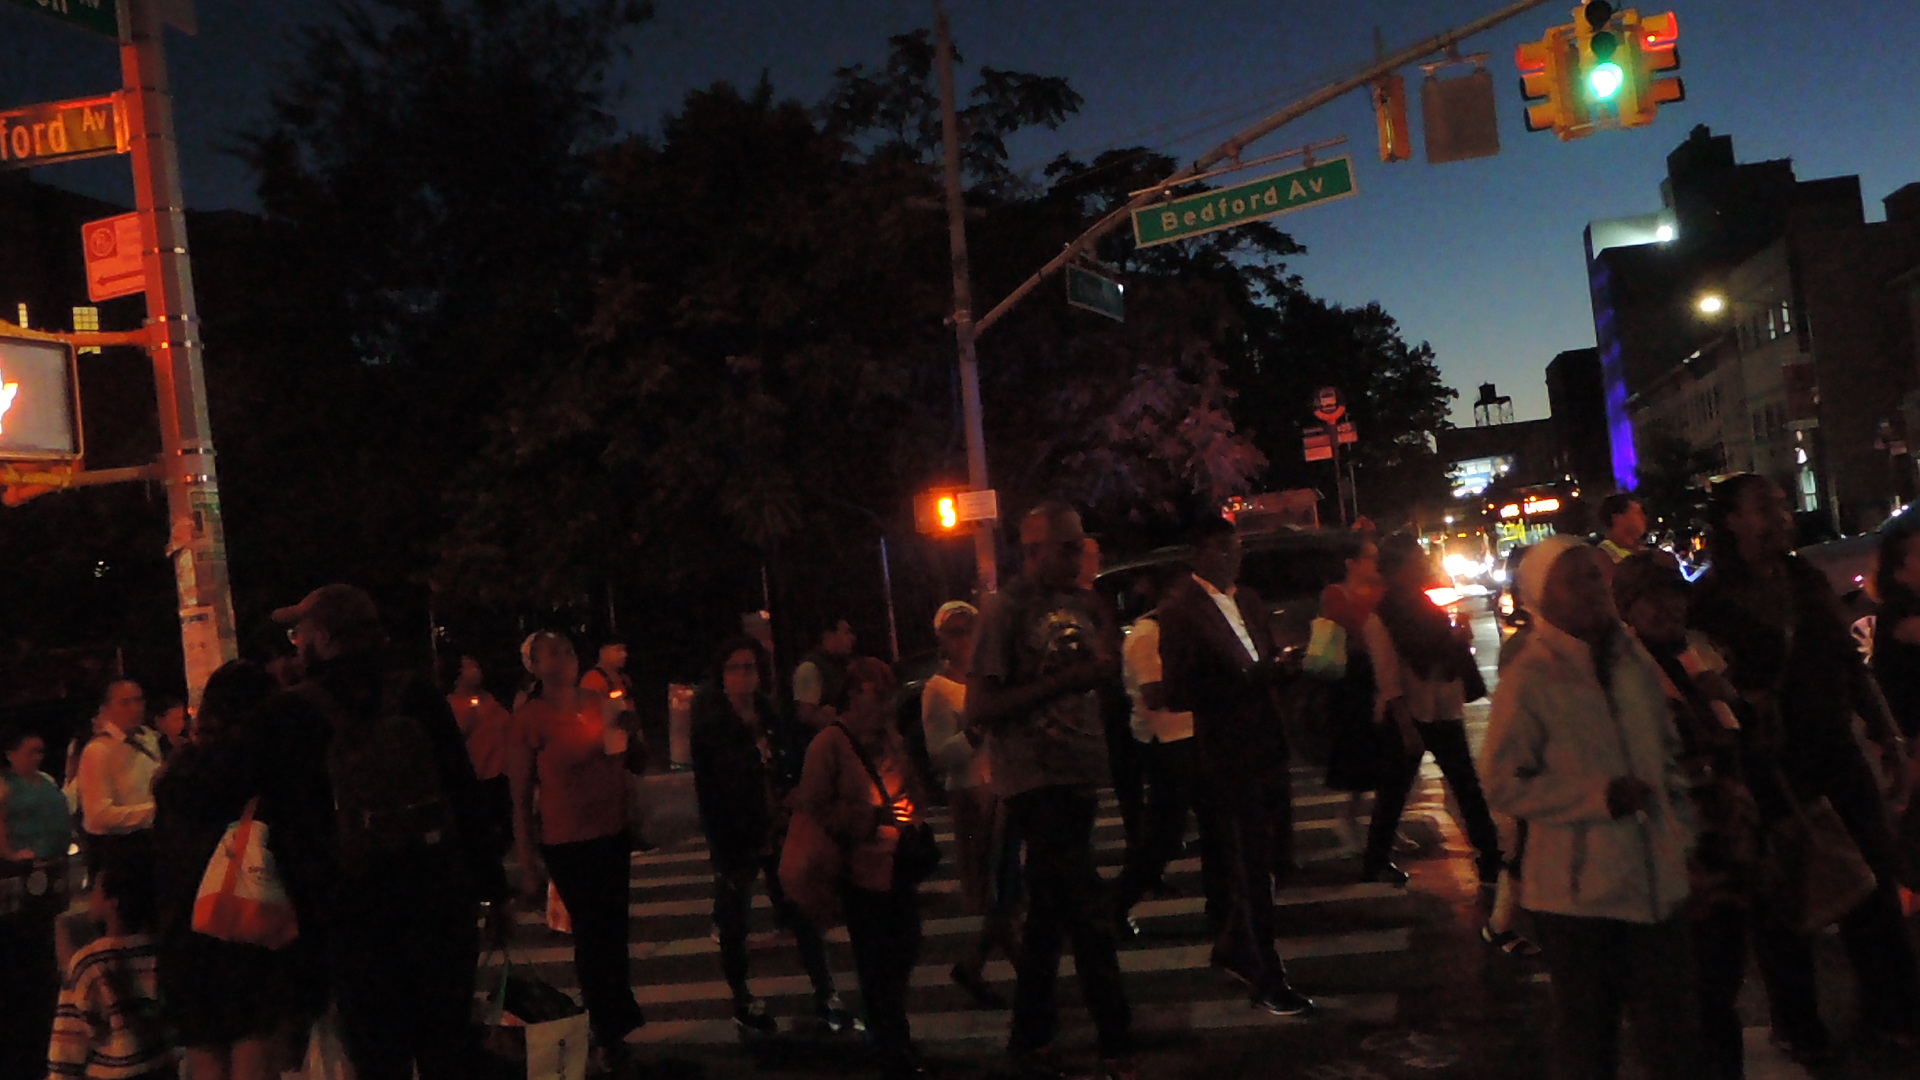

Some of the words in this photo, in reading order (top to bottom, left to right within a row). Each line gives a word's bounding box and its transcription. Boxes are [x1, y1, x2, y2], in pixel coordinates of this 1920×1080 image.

[81, 105, 108, 132] Av
[1161, 186, 1279, 231] Bedford
[1288, 176, 1324, 200] Av
